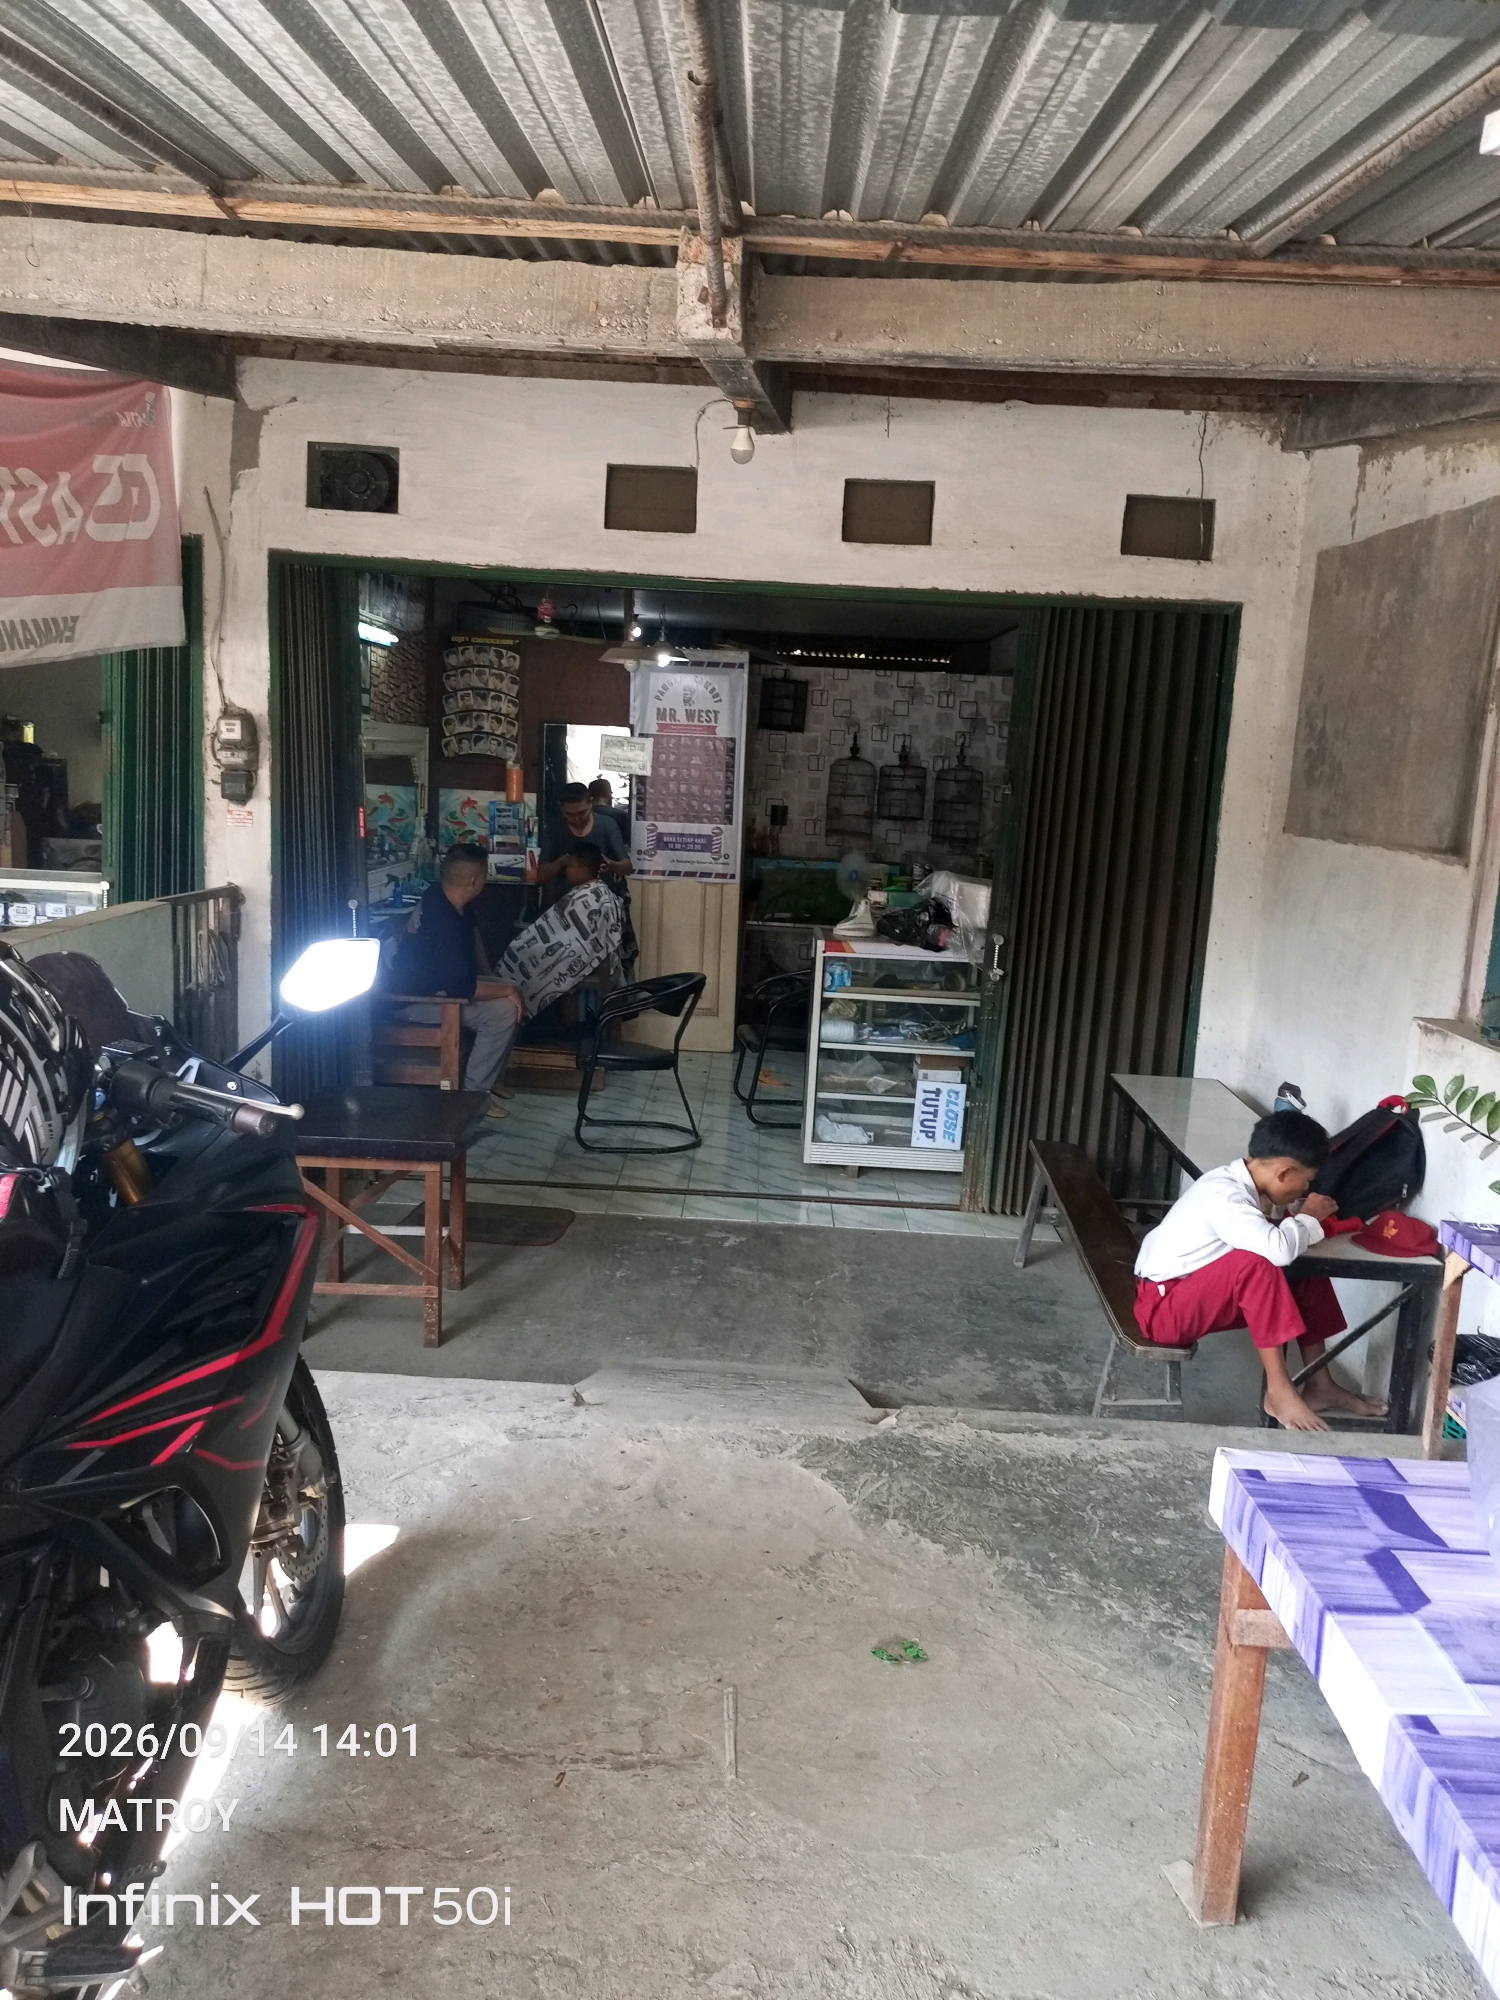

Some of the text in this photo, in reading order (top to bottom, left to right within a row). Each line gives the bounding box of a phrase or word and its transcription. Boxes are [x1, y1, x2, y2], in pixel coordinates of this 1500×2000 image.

[656, 707, 721, 725] MR. WEST
[920, 1088, 941, 1142] TUTUP
[943, 1088, 961, 1143] CLOSE
